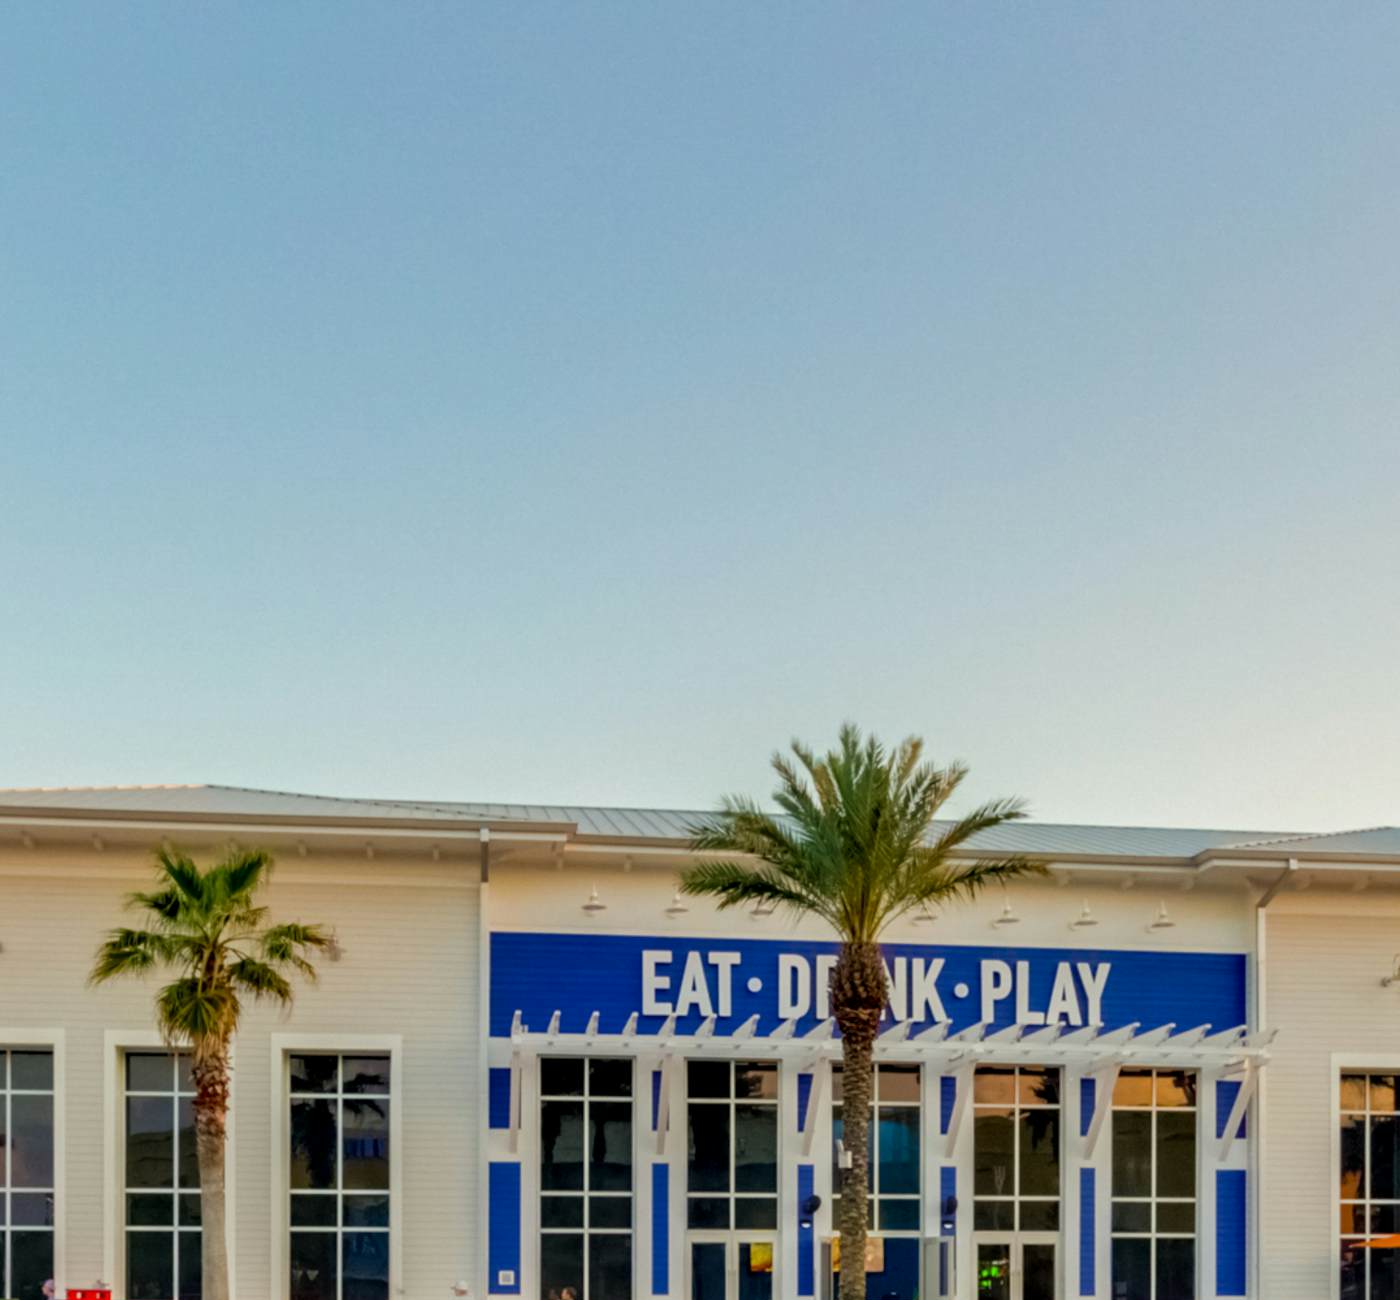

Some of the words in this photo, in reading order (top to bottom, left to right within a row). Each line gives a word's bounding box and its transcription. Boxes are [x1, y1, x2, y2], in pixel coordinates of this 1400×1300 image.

[642, 950, 741, 1017] EAT
[778, 953, 948, 1022] DRNK
[980, 959, 1112, 1026] PLAY
